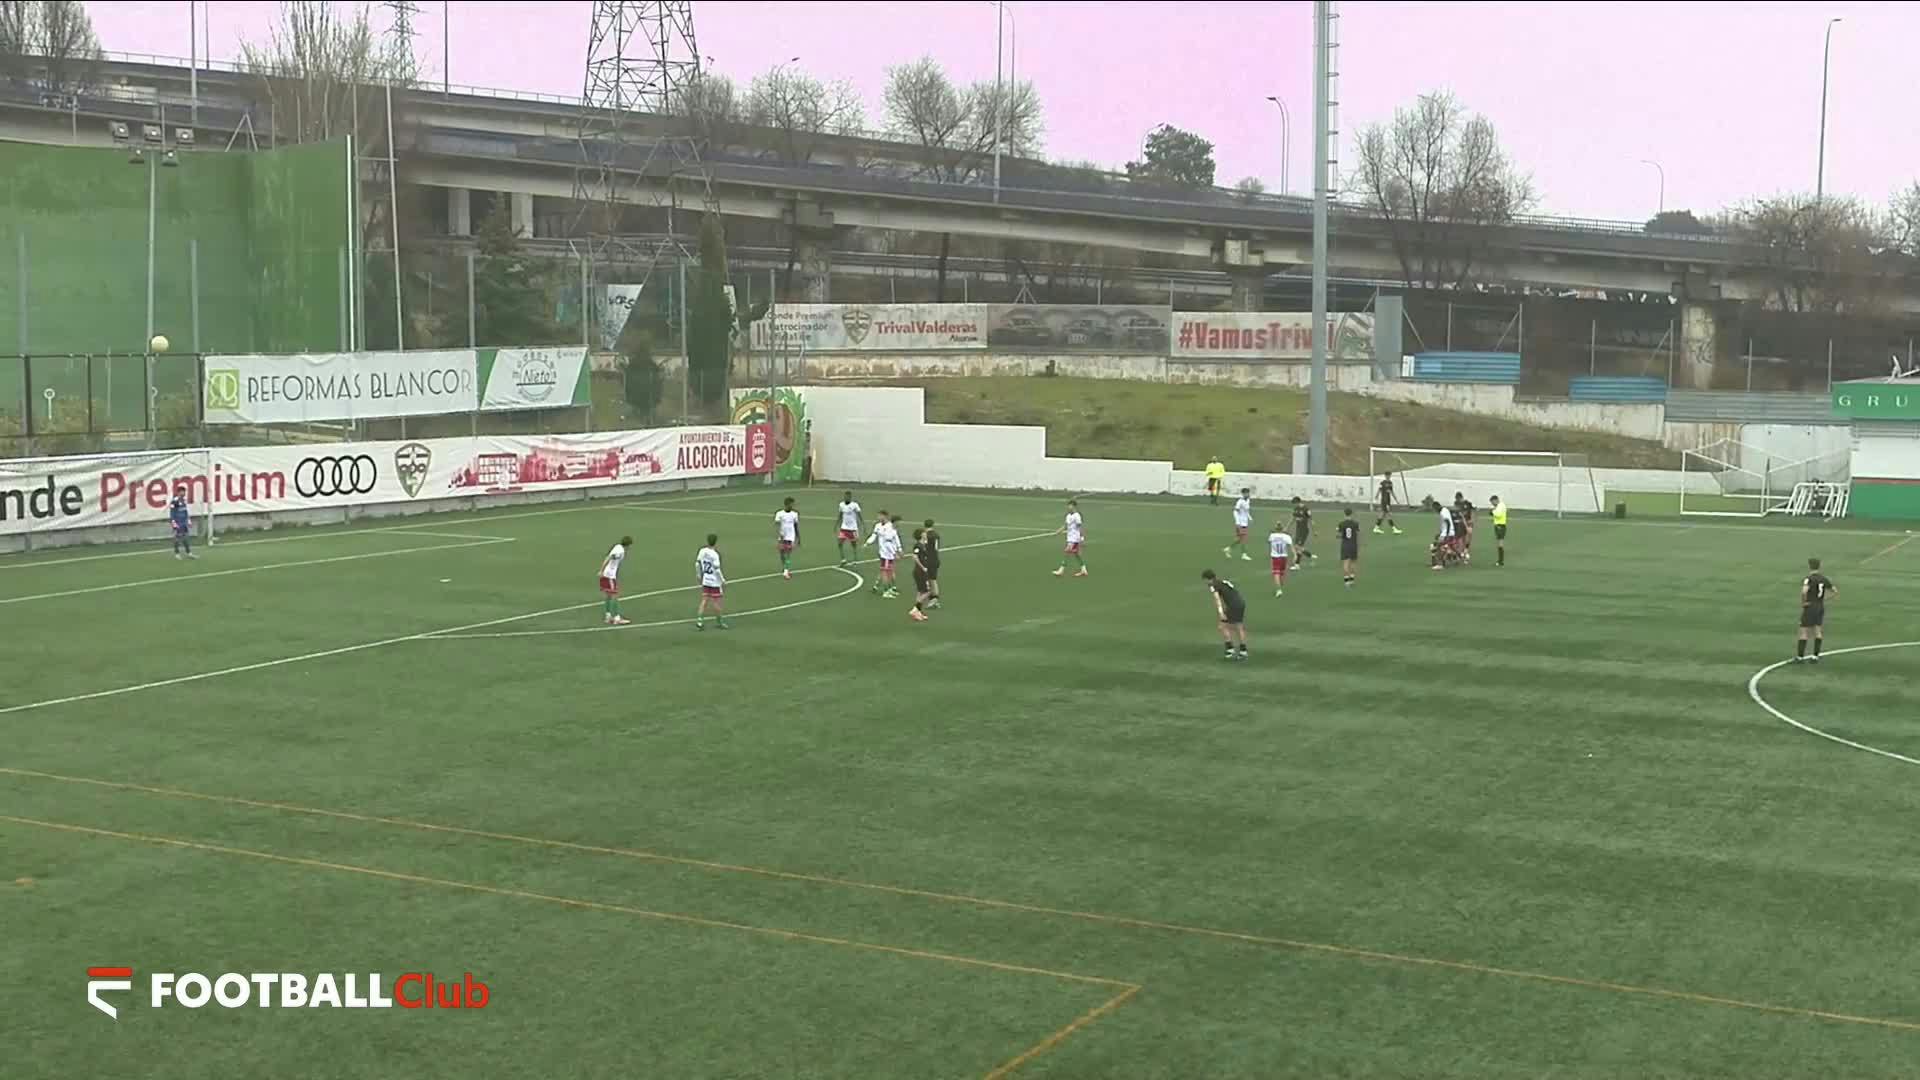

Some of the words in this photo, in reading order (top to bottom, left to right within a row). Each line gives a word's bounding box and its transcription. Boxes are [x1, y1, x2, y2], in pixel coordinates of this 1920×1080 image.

[873, 319, 977, 334] TrivalValderas
[1179, 321, 1336, 352] #VamosTrivl
[248, 373, 361, 403] REFORMAS
[723, 431, 731, 443] DE
[677, 438, 744, 470] ALCORCÓN
[0, 475, 83, 521] nde
[99, 464, 286, 513] Premium
